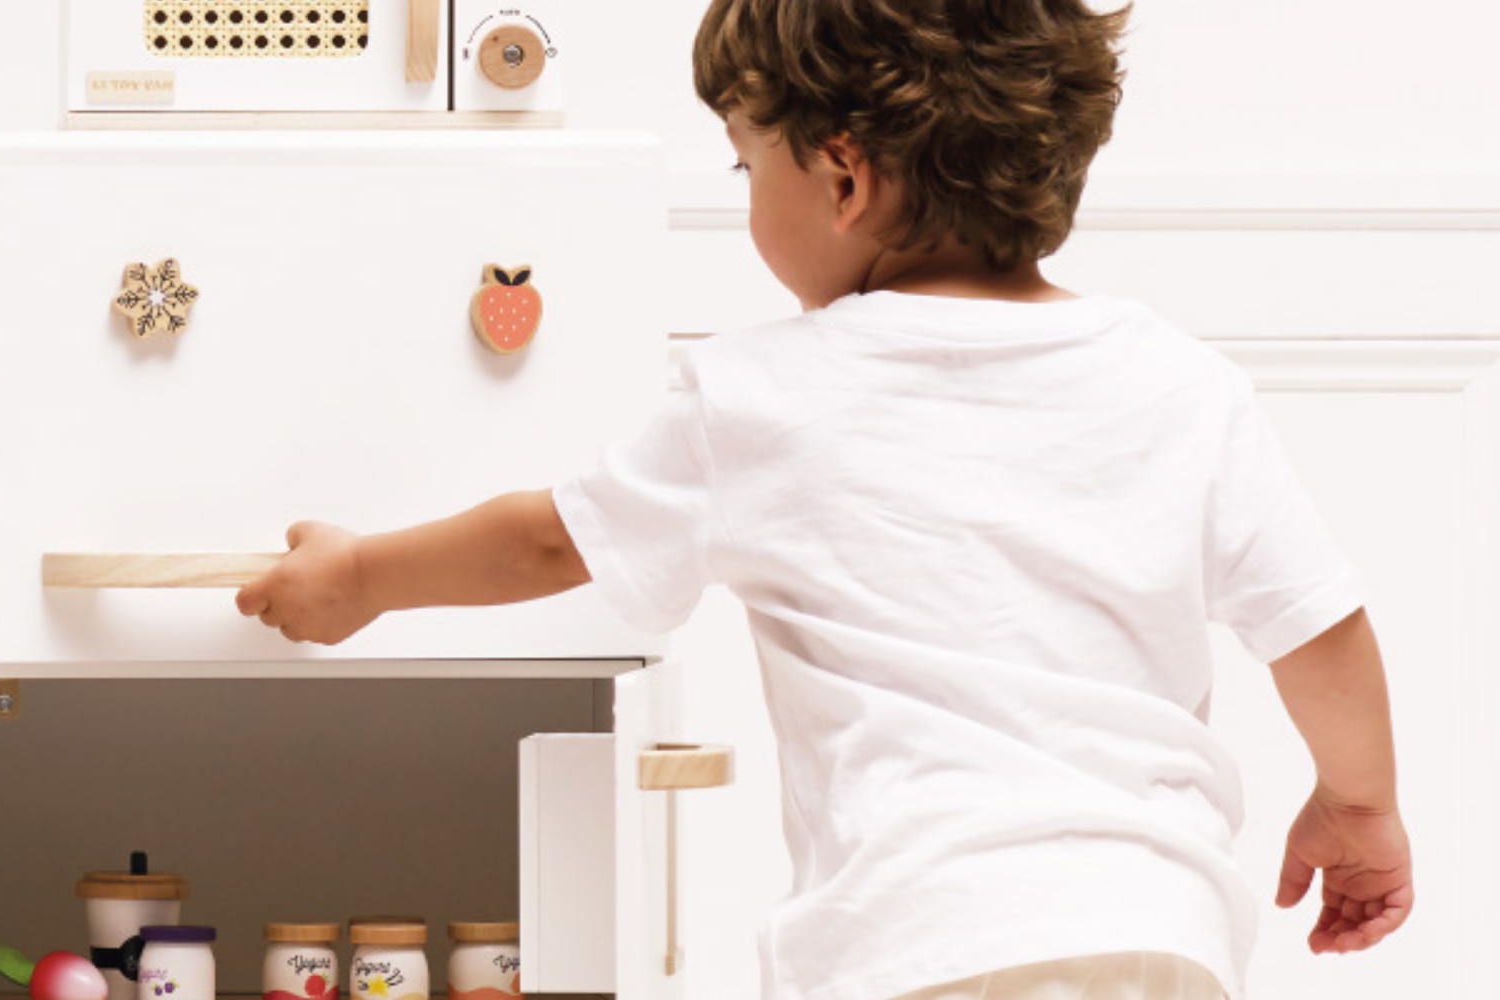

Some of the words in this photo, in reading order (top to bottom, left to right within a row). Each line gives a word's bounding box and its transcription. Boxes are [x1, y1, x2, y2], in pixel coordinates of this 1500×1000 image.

[92, 80, 108, 91] LE
[111, 80, 140, 91] TOY
[144, 80, 173, 91] VAN
[287, 955, 330, 974] Yogurt
